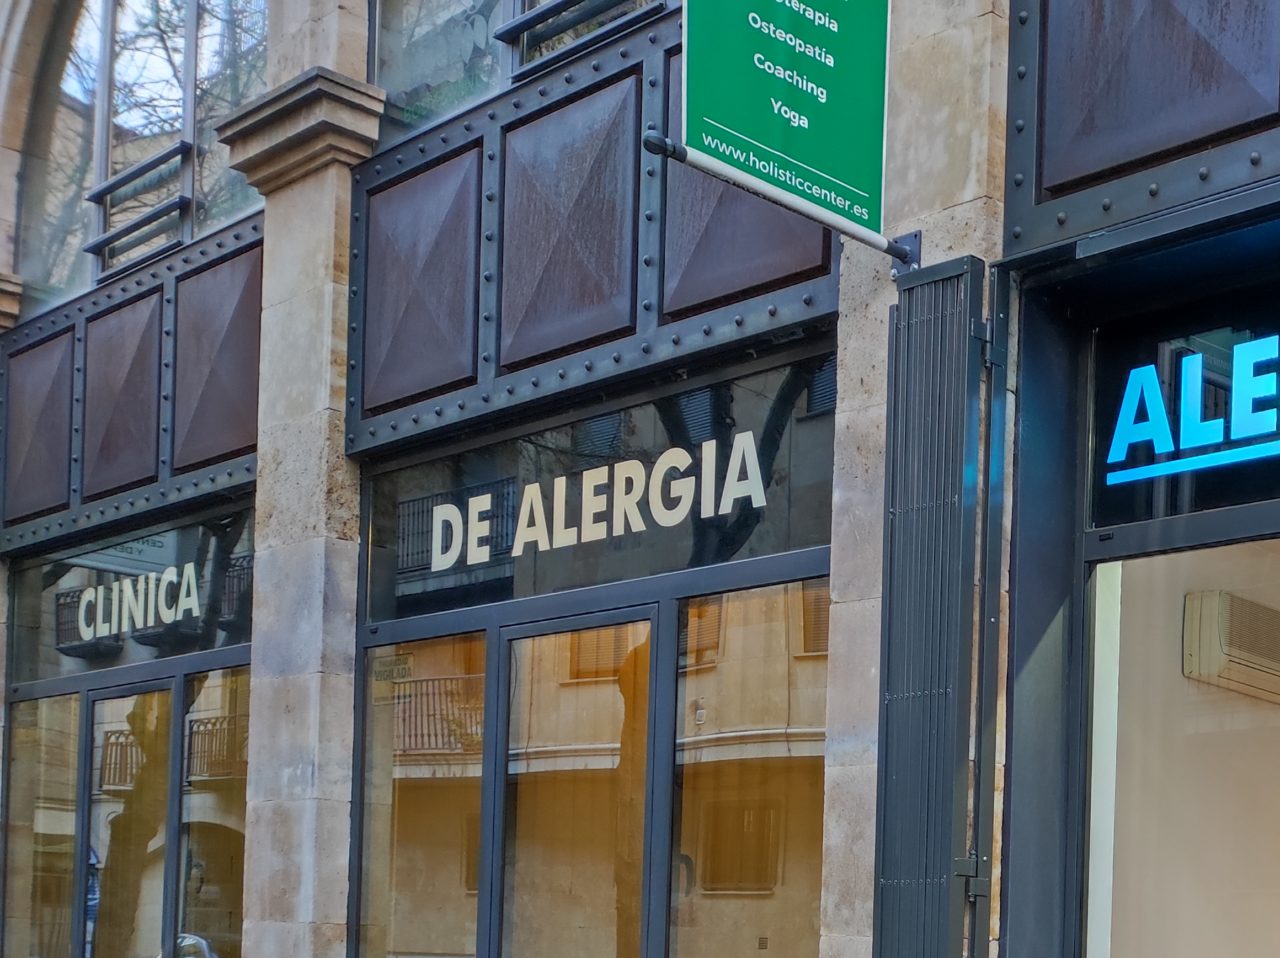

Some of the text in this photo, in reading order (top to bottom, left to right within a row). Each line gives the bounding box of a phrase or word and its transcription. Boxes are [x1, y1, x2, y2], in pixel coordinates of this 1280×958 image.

[753, 53, 827, 103] Coaching
[770, 97, 809, 129] Yoga
[702, 133, 869, 219] www.holisticcenter.es
[431, 431, 767, 572] DE ALERGIA
[77, 561, 201, 642] CLINICA
